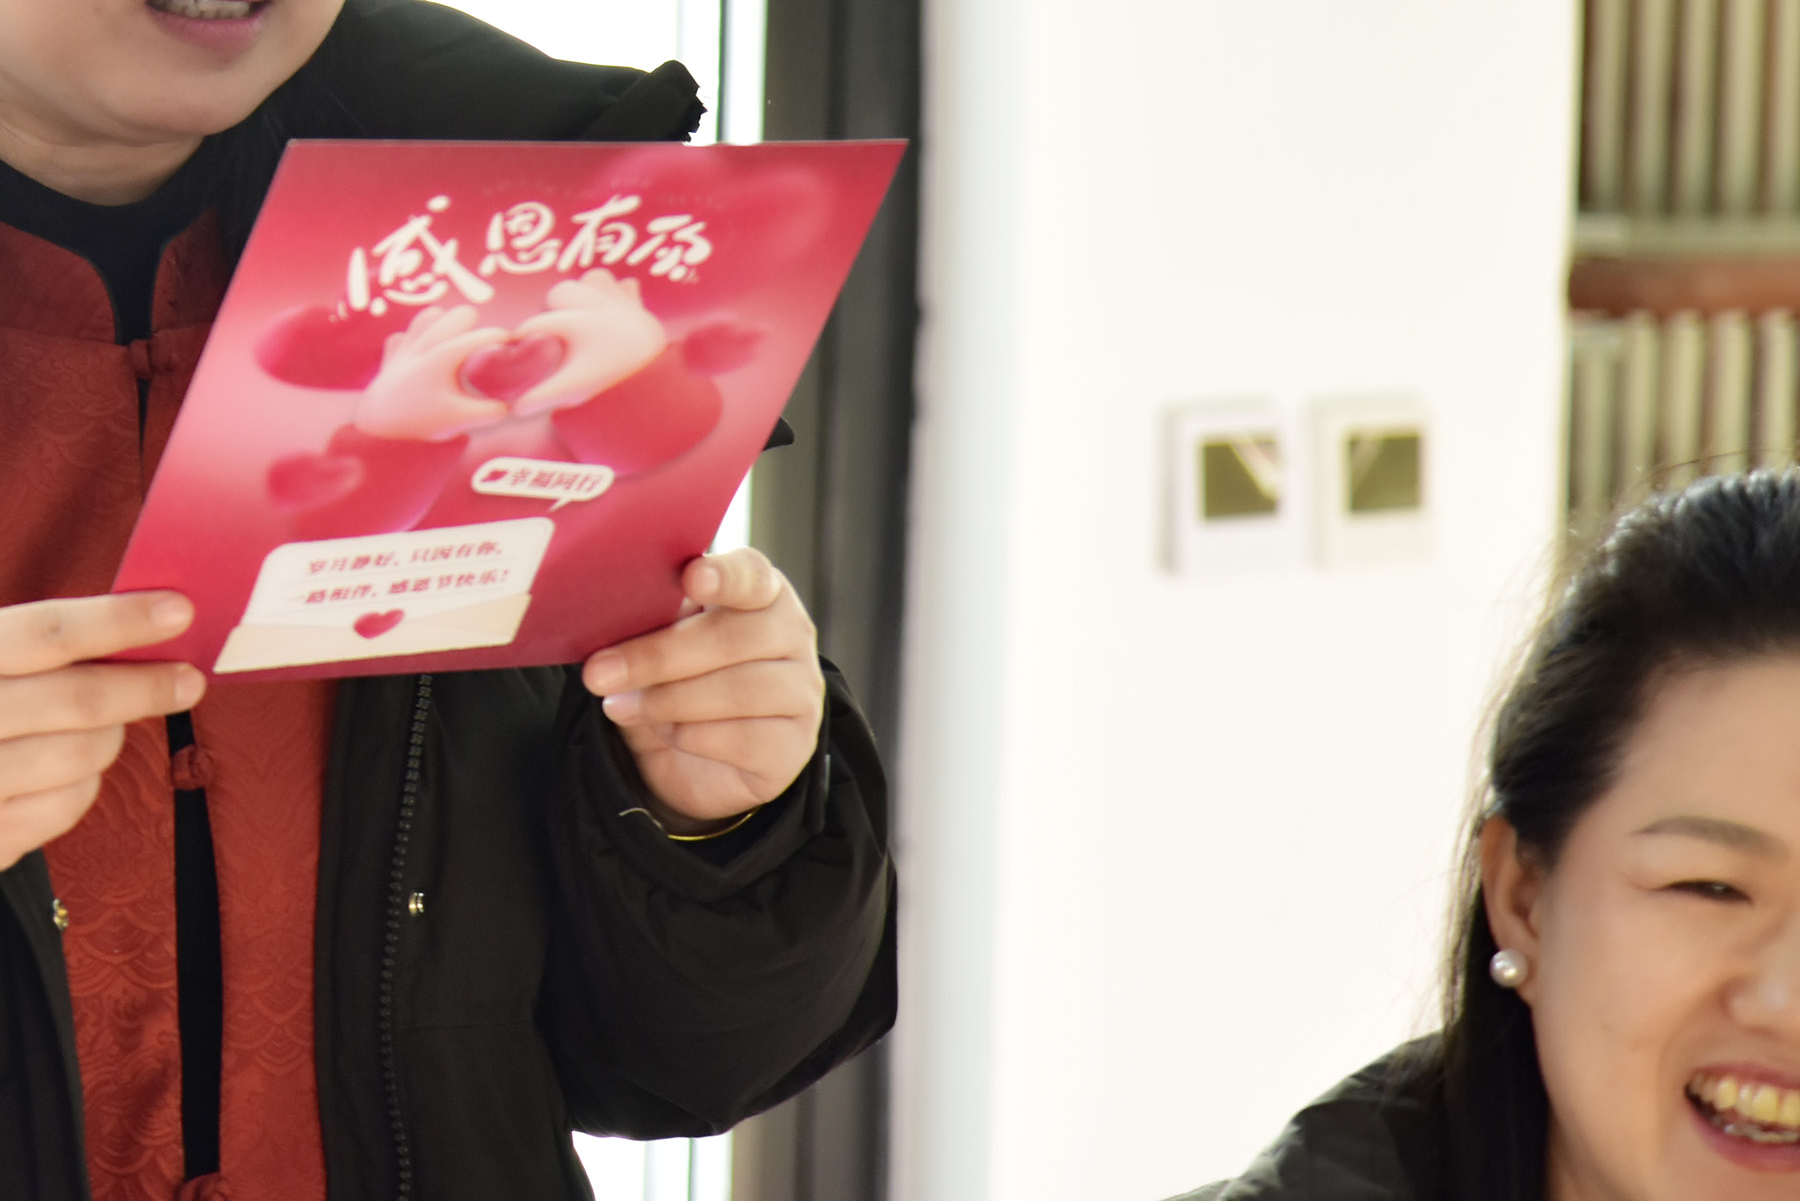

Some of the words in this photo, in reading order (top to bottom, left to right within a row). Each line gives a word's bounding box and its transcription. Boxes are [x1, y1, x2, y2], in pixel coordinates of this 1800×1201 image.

[346, 194, 713, 317] 感恩有你
[510, 467, 602, 493] 幸福同行
